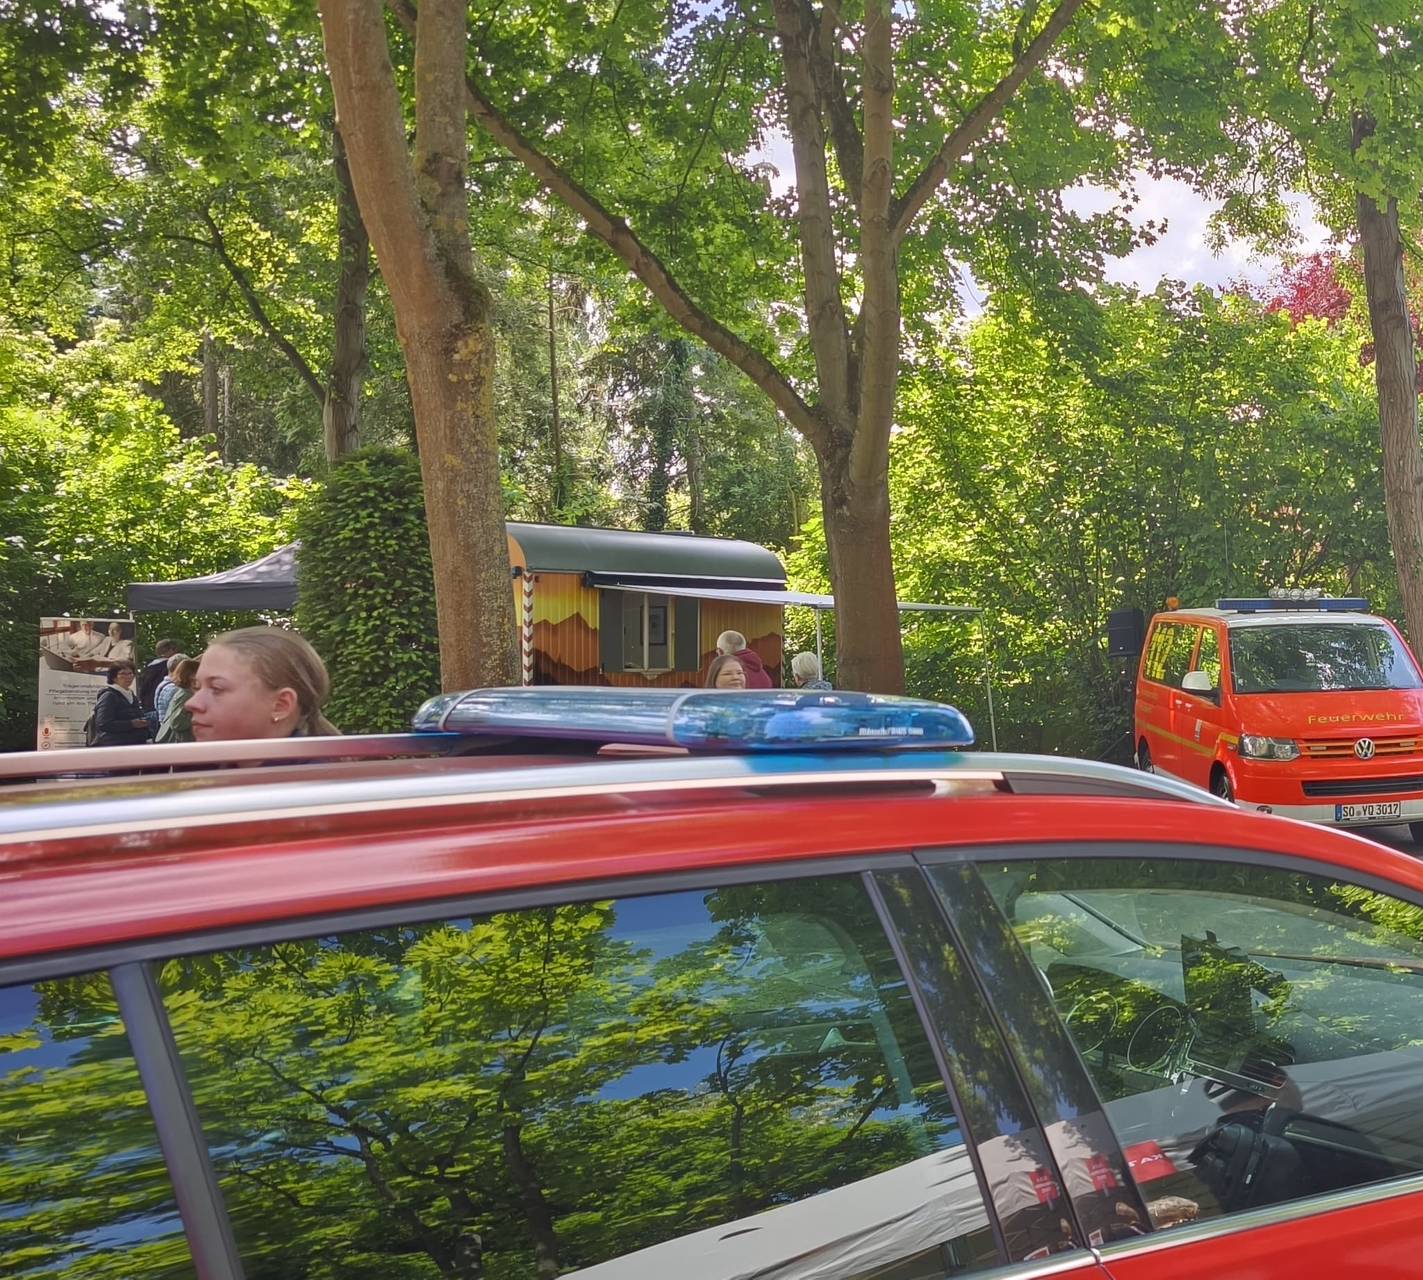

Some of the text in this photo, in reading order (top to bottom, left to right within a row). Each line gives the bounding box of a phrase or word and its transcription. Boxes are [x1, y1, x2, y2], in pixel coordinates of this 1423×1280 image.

[1307, 711, 1405, 725] Feuerwehr
[1342, 806, 1355, 817] SO
[1375, 803, 1399, 815] 3017
